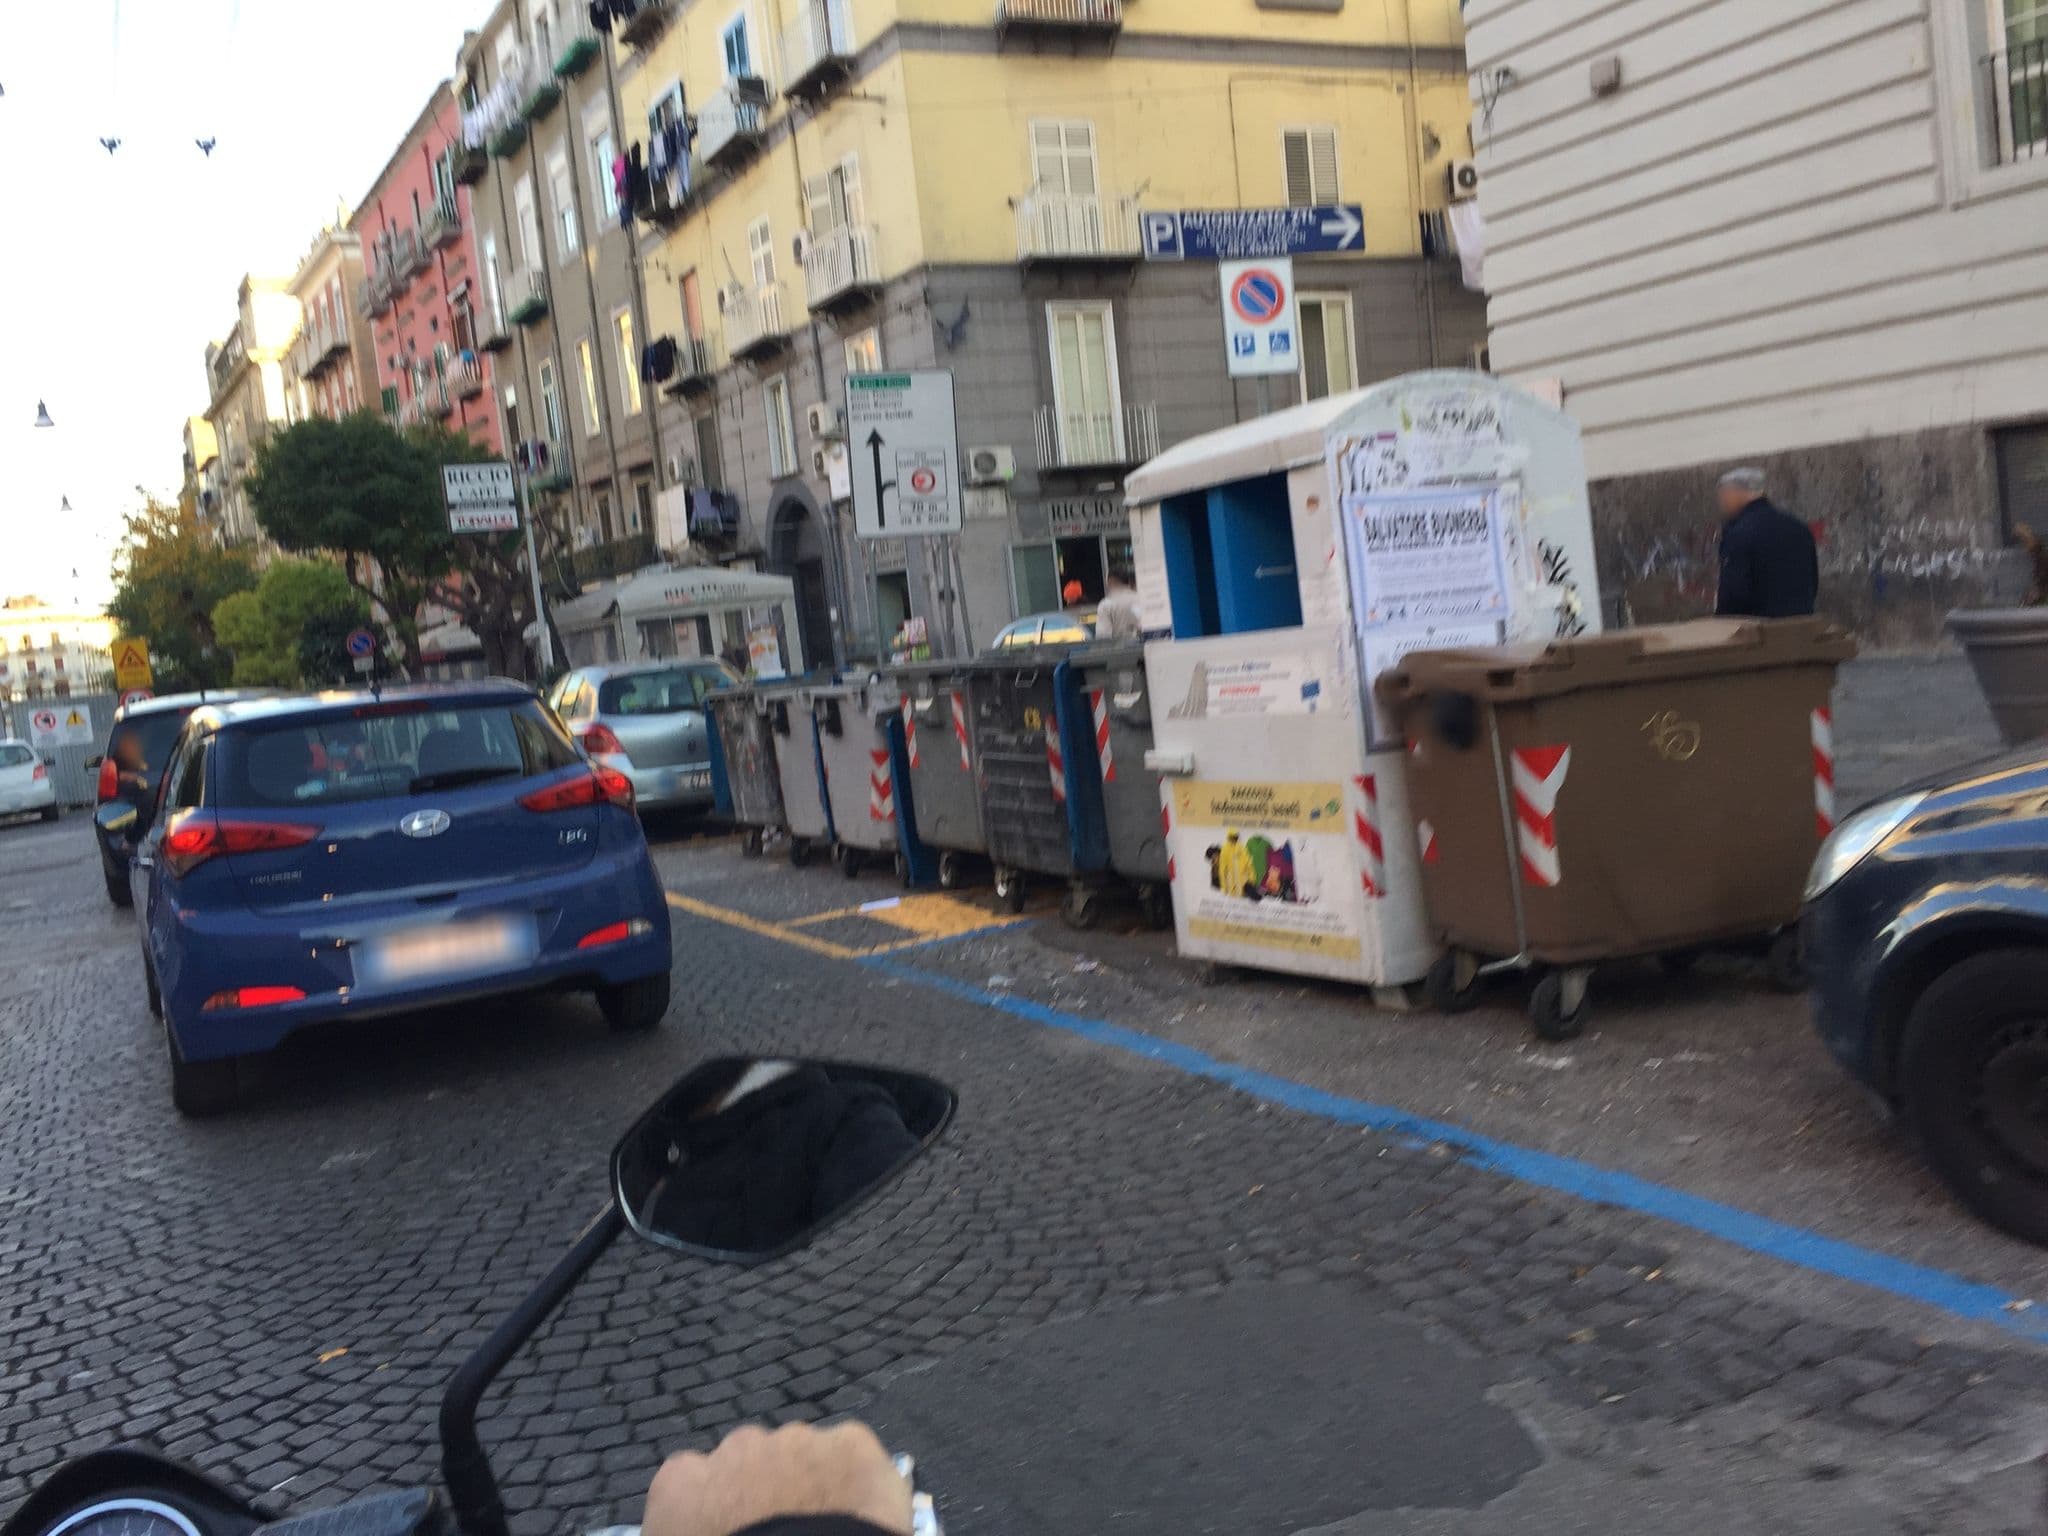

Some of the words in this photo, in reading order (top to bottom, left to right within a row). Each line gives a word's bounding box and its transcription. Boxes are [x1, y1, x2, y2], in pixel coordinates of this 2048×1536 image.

[1150, 214, 1174, 252] P
[447, 469, 509, 485] RICCIO
[1050, 500, 1114, 521] RICCIO
[1363, 511, 1428, 542] SALVATORE
